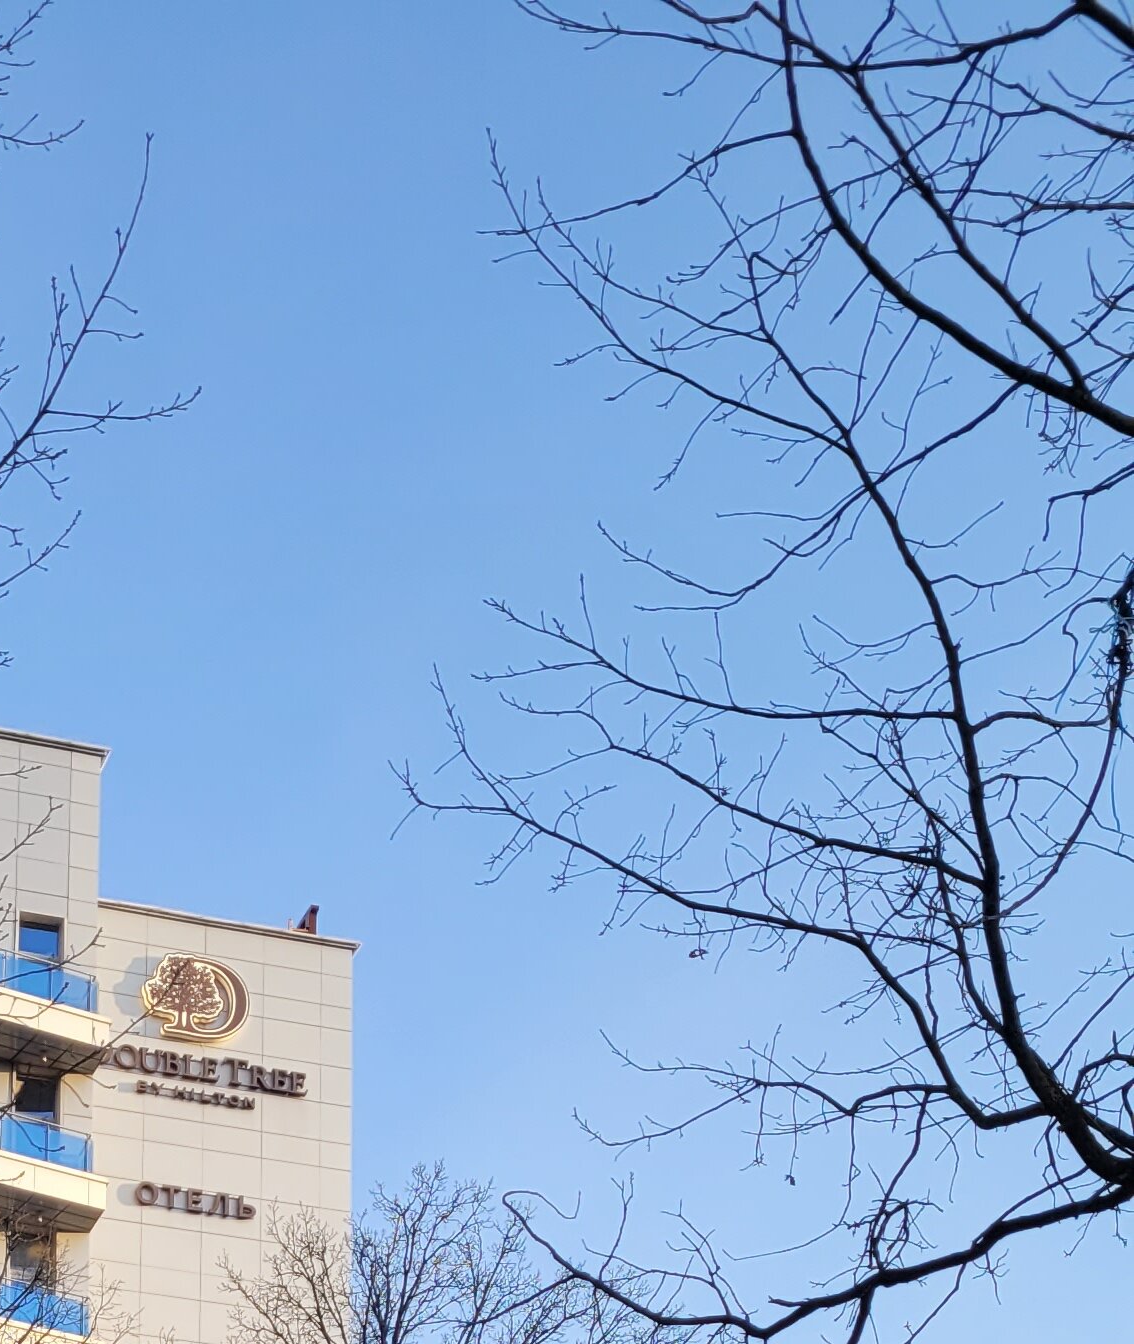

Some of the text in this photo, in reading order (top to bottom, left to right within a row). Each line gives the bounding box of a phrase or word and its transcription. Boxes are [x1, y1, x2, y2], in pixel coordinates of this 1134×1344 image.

[136, 1080, 256, 1110] BY HILTON
[135, 1181, 257, 1219] ОТЕЛЬ
